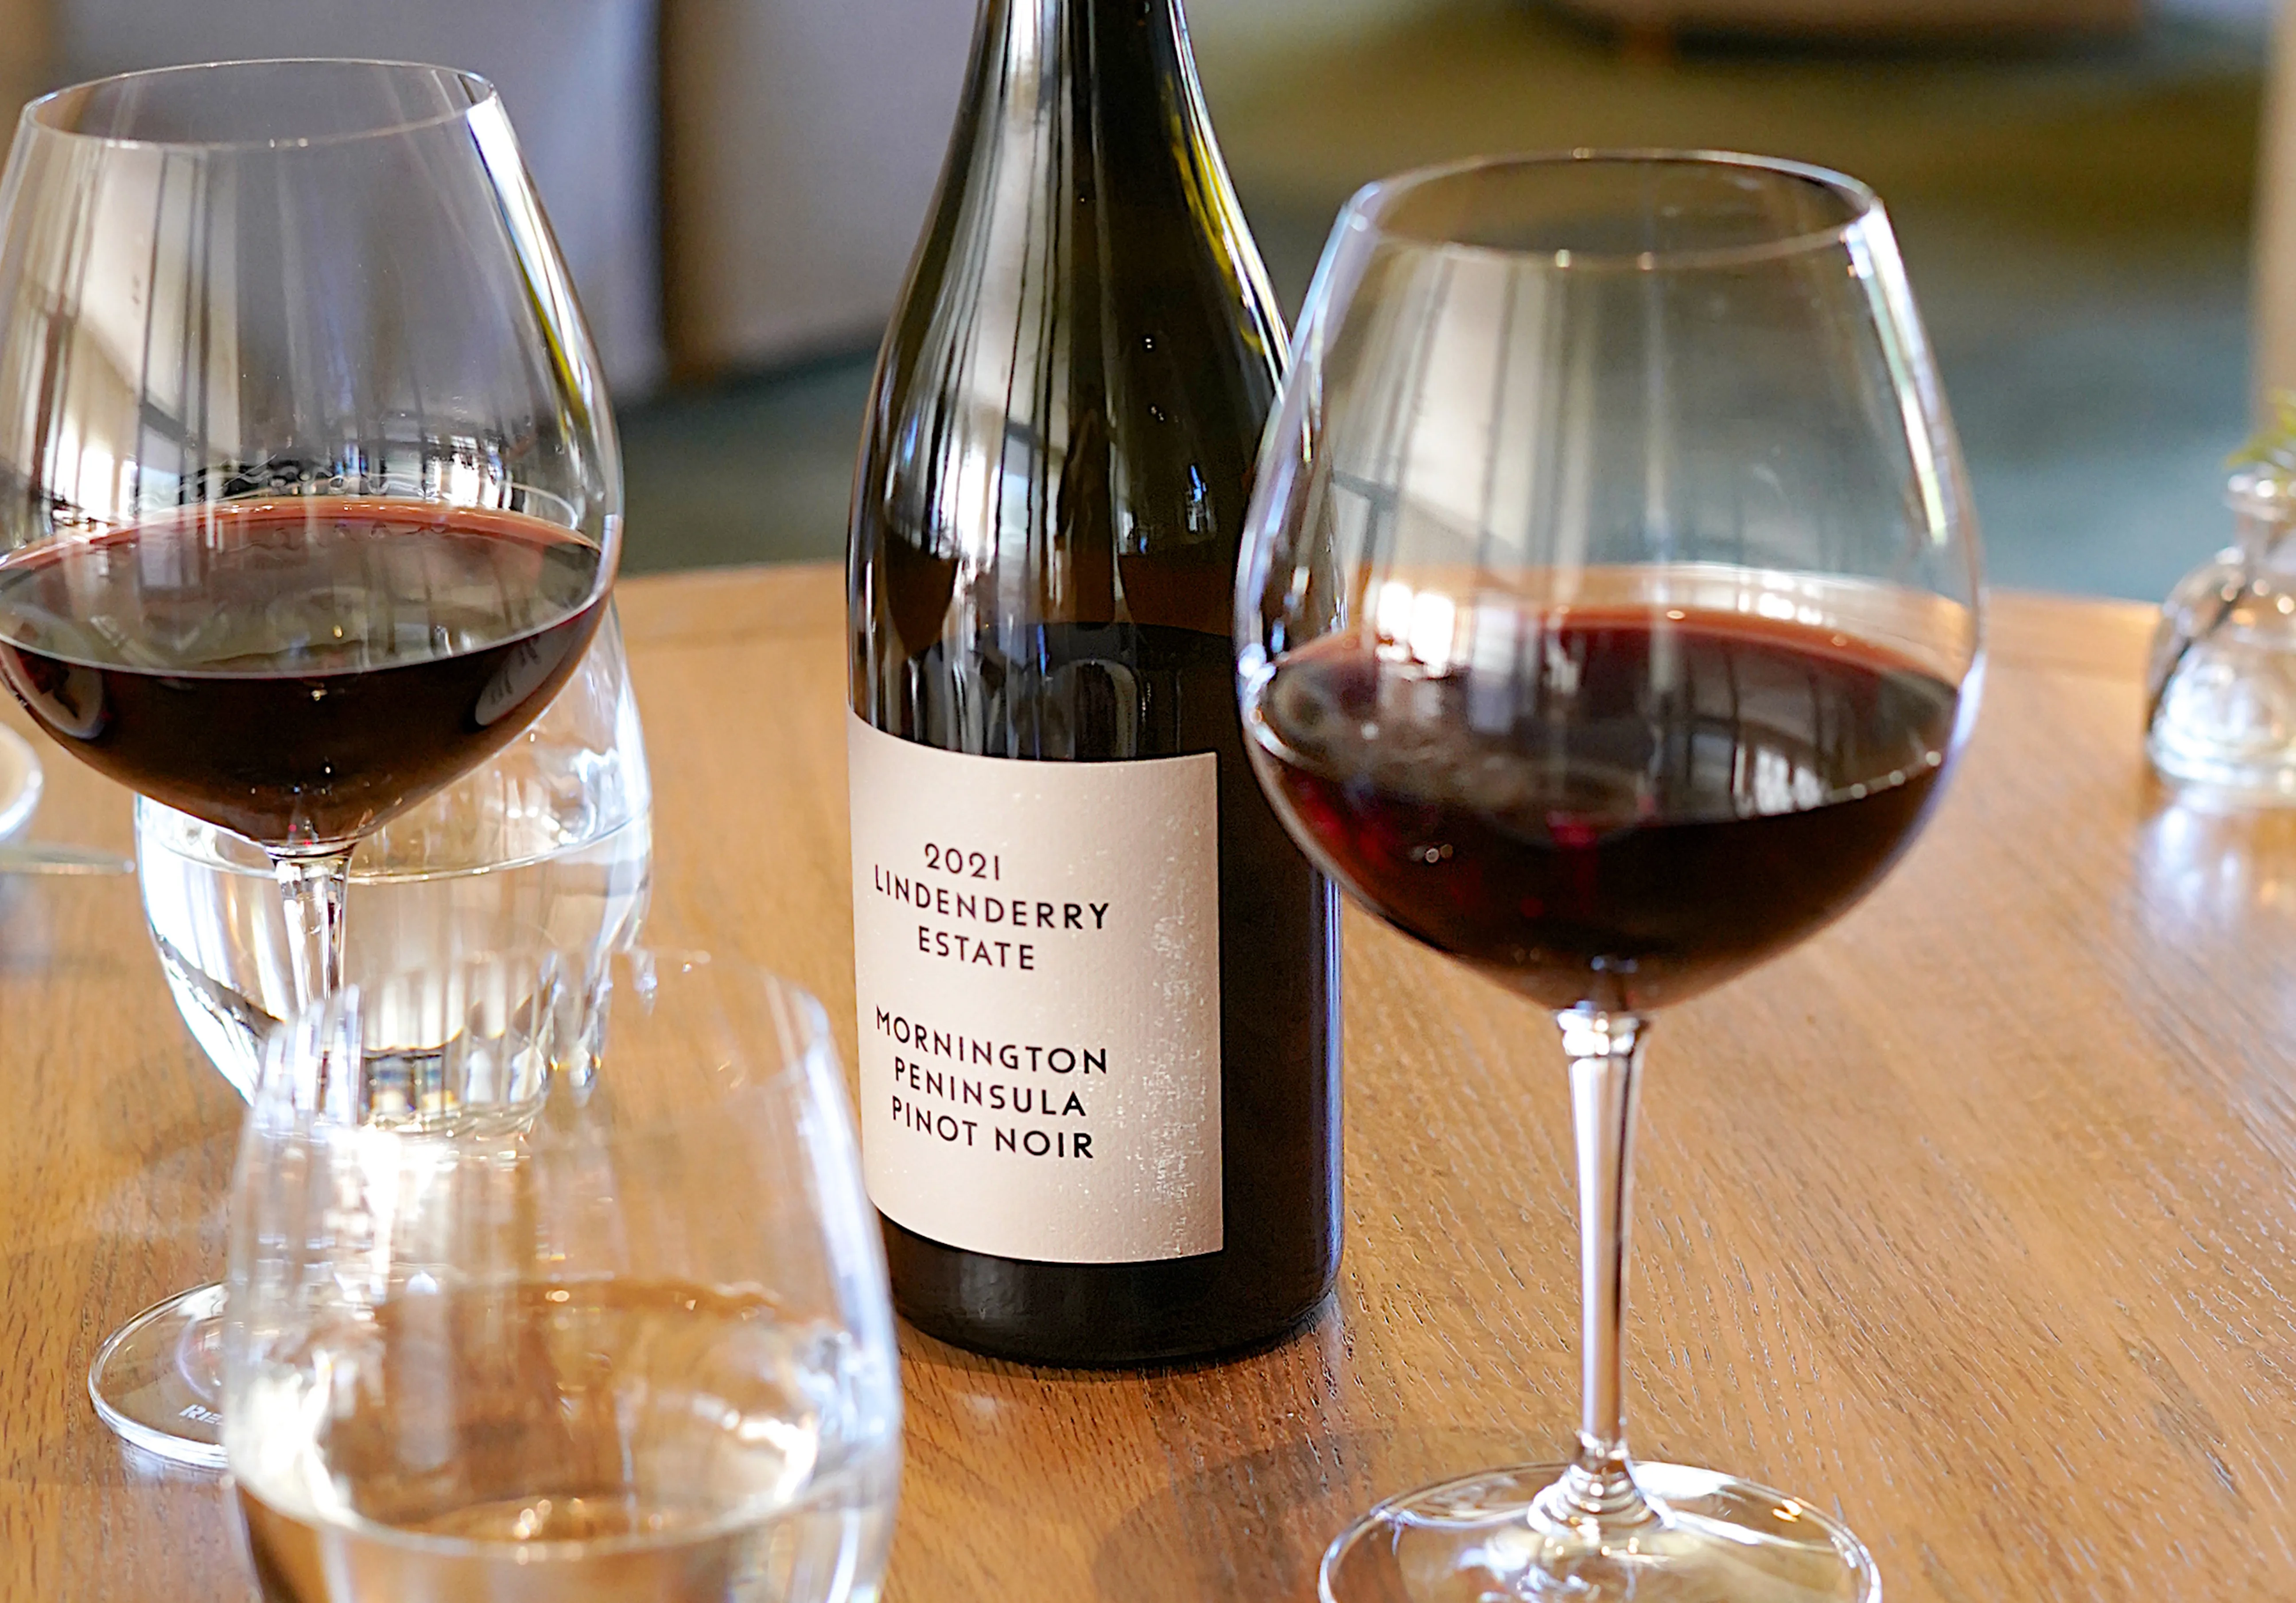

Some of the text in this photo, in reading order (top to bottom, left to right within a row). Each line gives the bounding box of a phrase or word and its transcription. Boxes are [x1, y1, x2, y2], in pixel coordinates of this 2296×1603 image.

[925, 842, 999, 881] 2021
[875, 864, 1109, 930] LINDENDERRY
[918, 925, 1034, 971] ESTATE
[876, 1005, 1107, 1075] MORNINGTON
[895, 1056, 1087, 1117] PENINSULA
[892, 1095, 1094, 1159] PINOT NOIR
[179, 1404, 225, 1426] RIE
